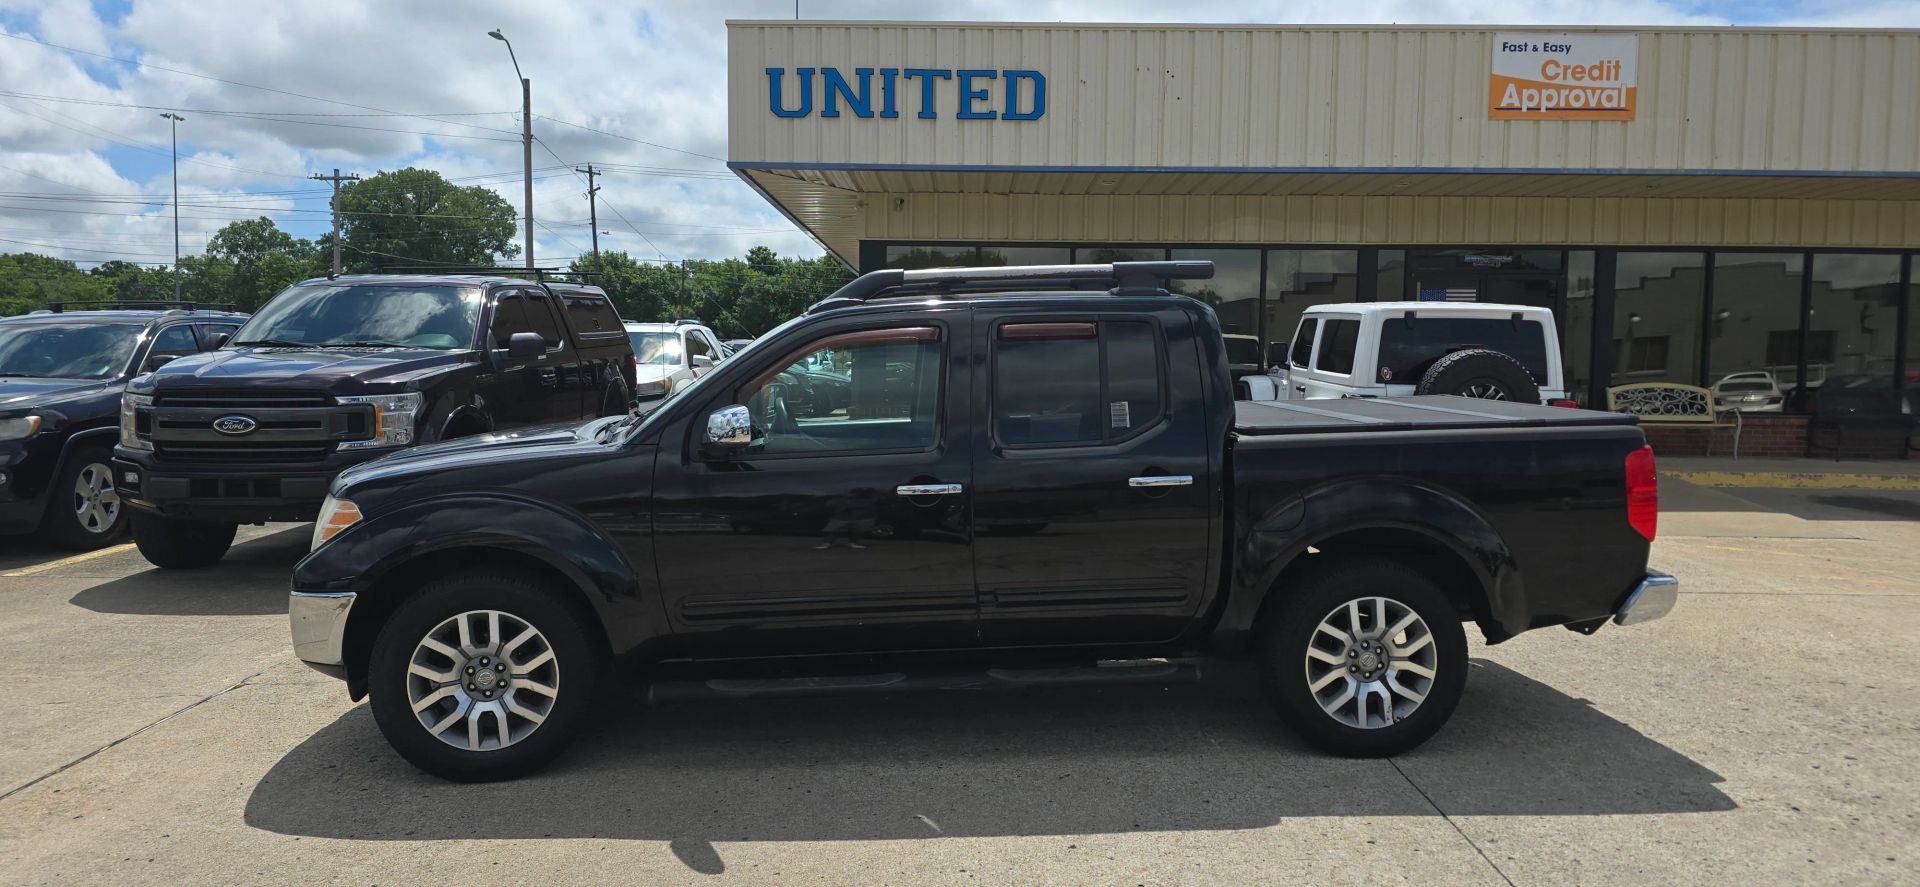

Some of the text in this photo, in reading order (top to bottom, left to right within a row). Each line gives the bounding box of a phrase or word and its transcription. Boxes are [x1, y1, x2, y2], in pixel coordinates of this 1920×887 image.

[1502, 42, 1572, 54] Fast & Easy
[1541, 59, 1622, 81] Credit
[765, 67, 1046, 120] UNITED
[1500, 83, 1627, 112] Approval
[222, 419, 245, 430] Ford
